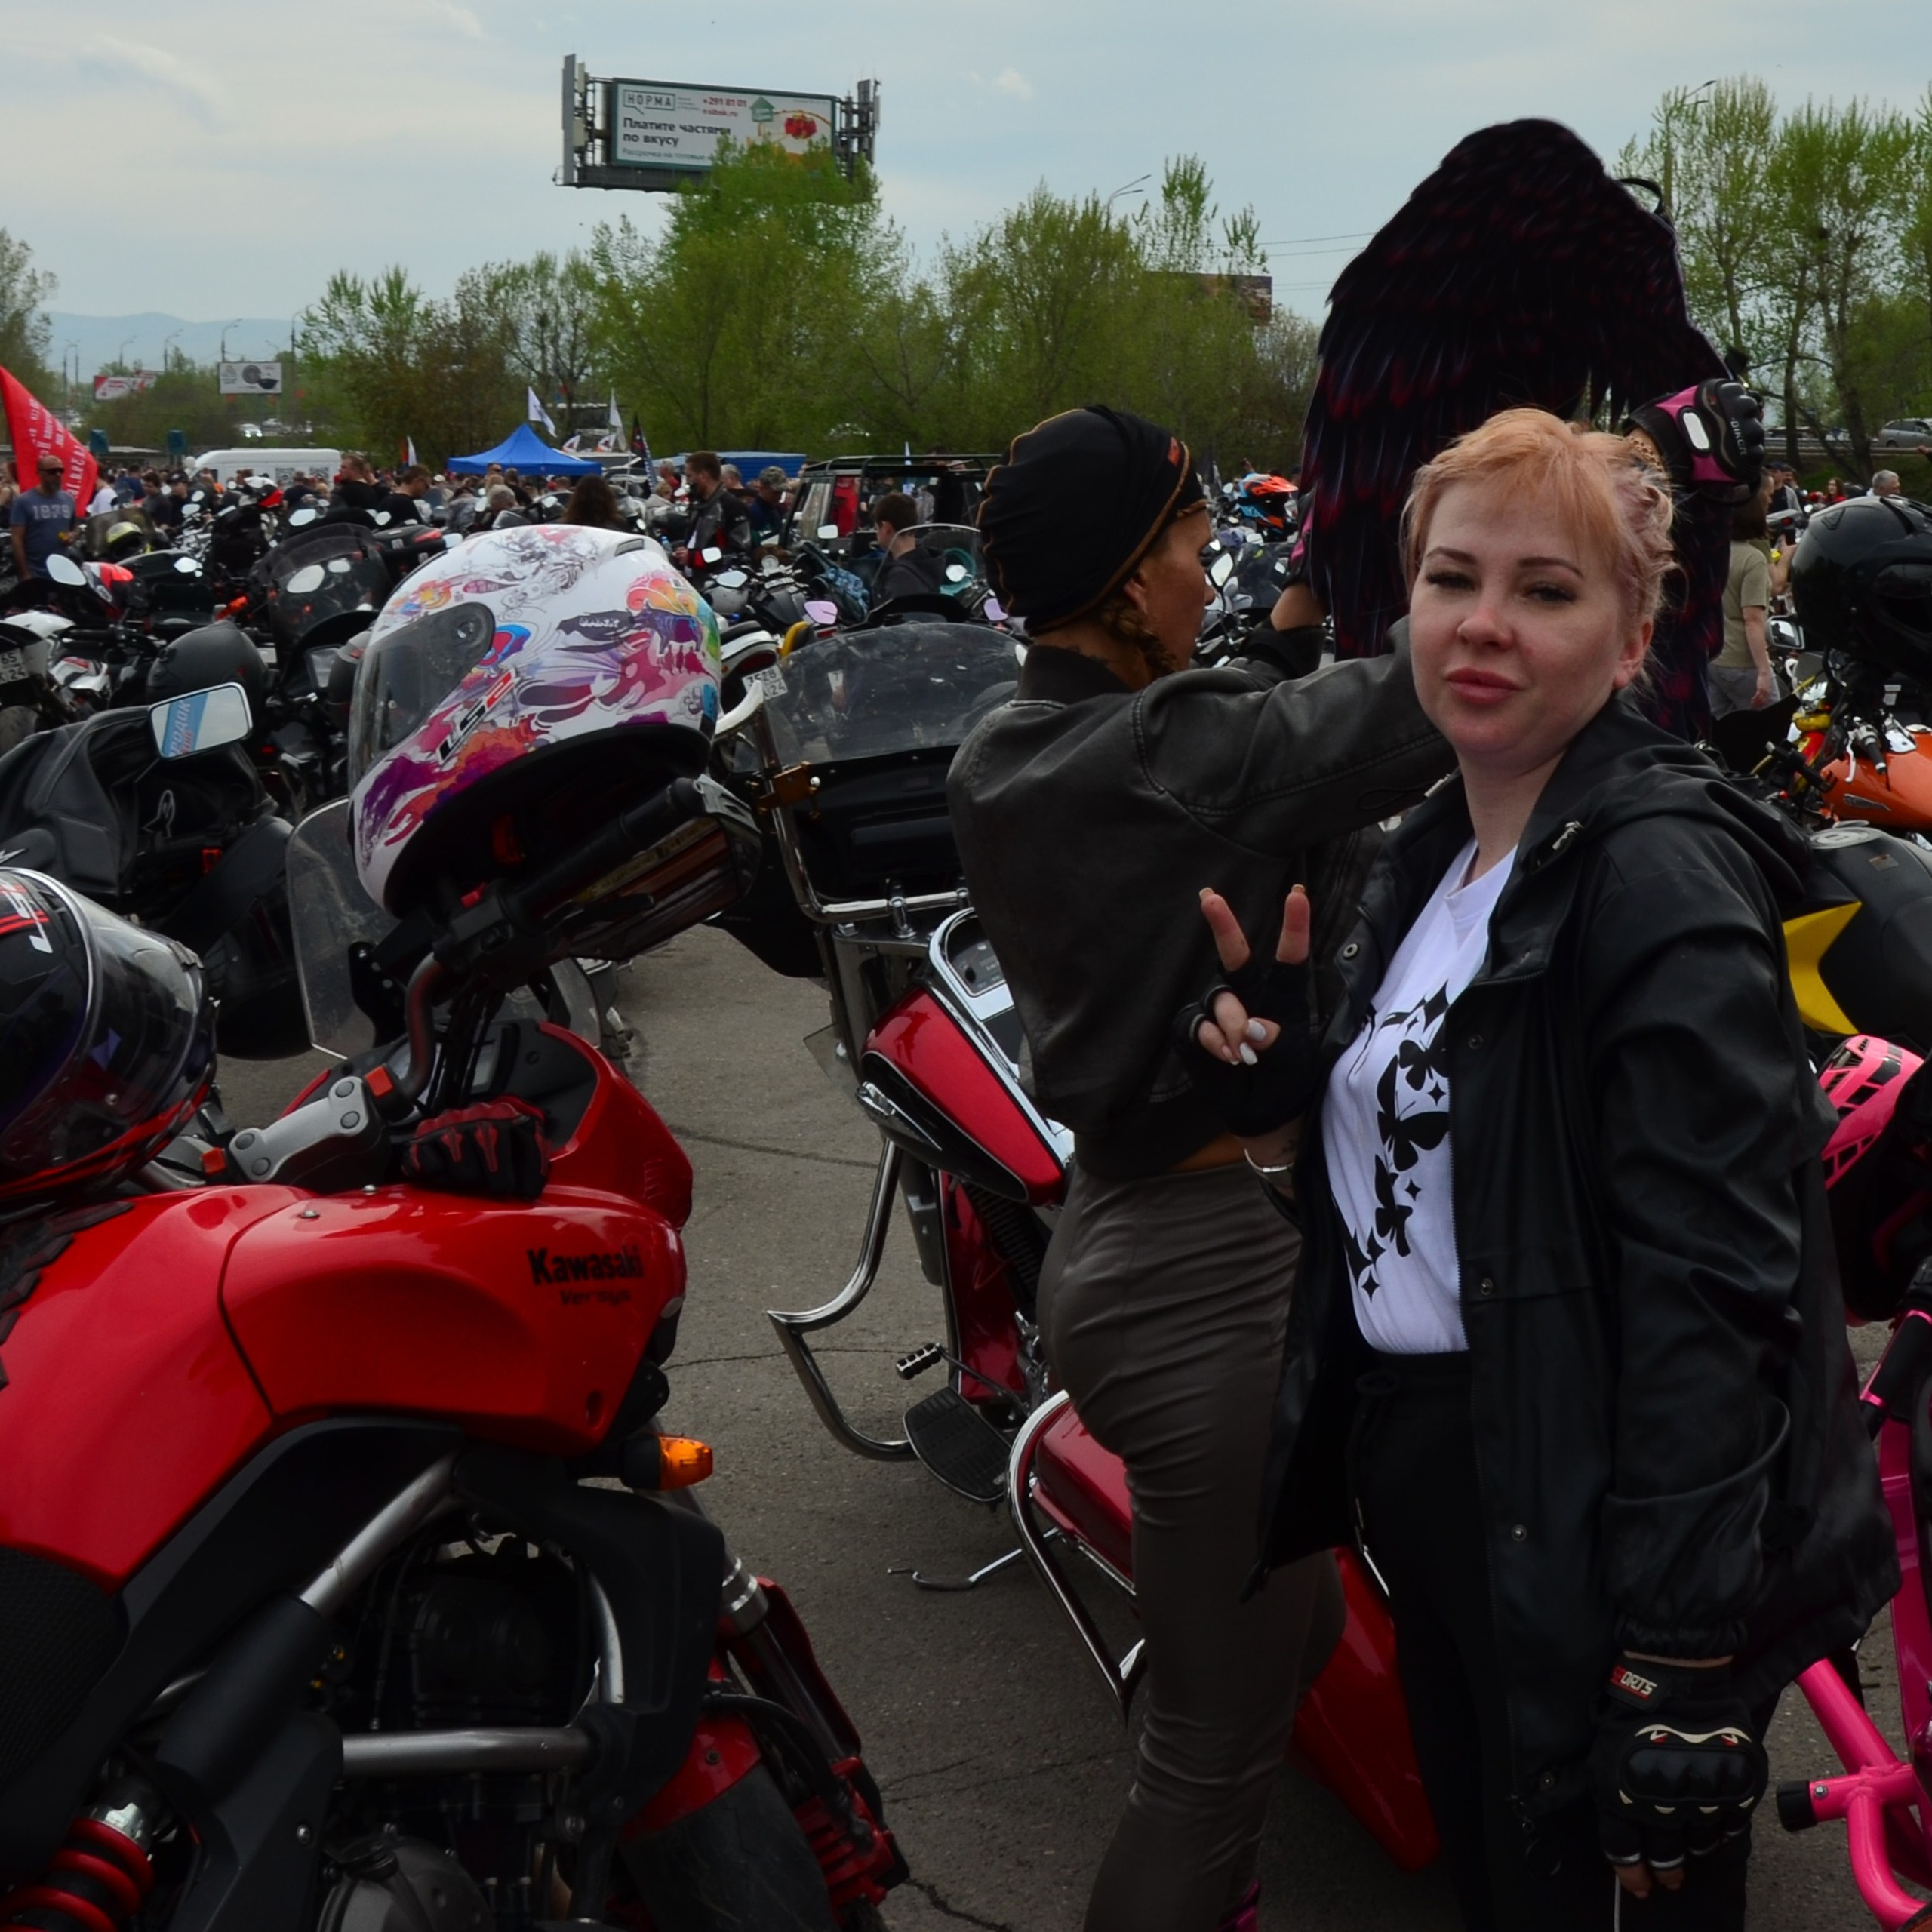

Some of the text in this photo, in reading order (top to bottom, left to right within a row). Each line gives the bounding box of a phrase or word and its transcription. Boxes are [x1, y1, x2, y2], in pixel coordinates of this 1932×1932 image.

[627, 94, 672, 107] НОРМА
[623, 117, 675, 132] Платите
[623, 134, 679, 147] по вкусу
[33, 505, 71, 520] 1879
[769, 682, 786, 695] 24
[438, 671, 516, 761] LS2
[526, 1245, 645, 1286] Kawasaki
